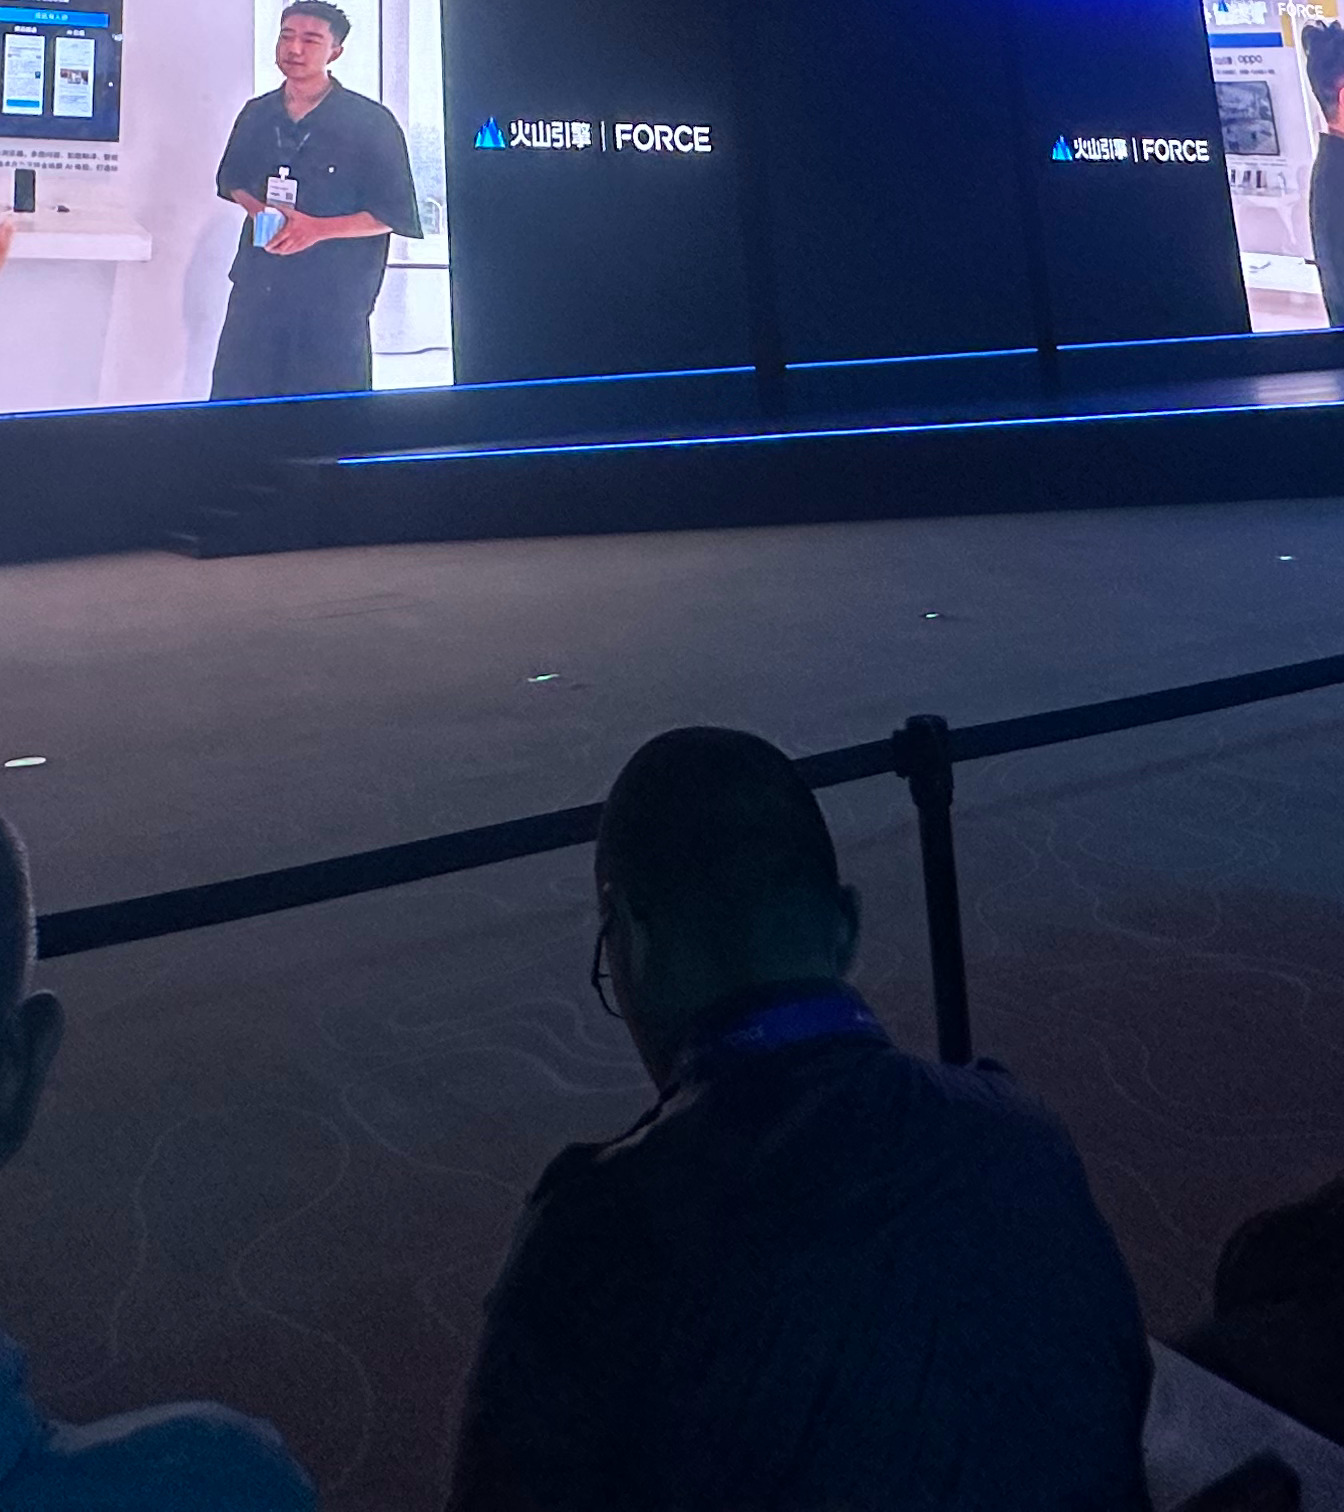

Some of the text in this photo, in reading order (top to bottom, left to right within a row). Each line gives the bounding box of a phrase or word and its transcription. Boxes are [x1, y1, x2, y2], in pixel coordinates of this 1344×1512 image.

[509, 119, 712, 152] 火山引擎 FORCE
[1142, 138, 1211, 162] FORCE
